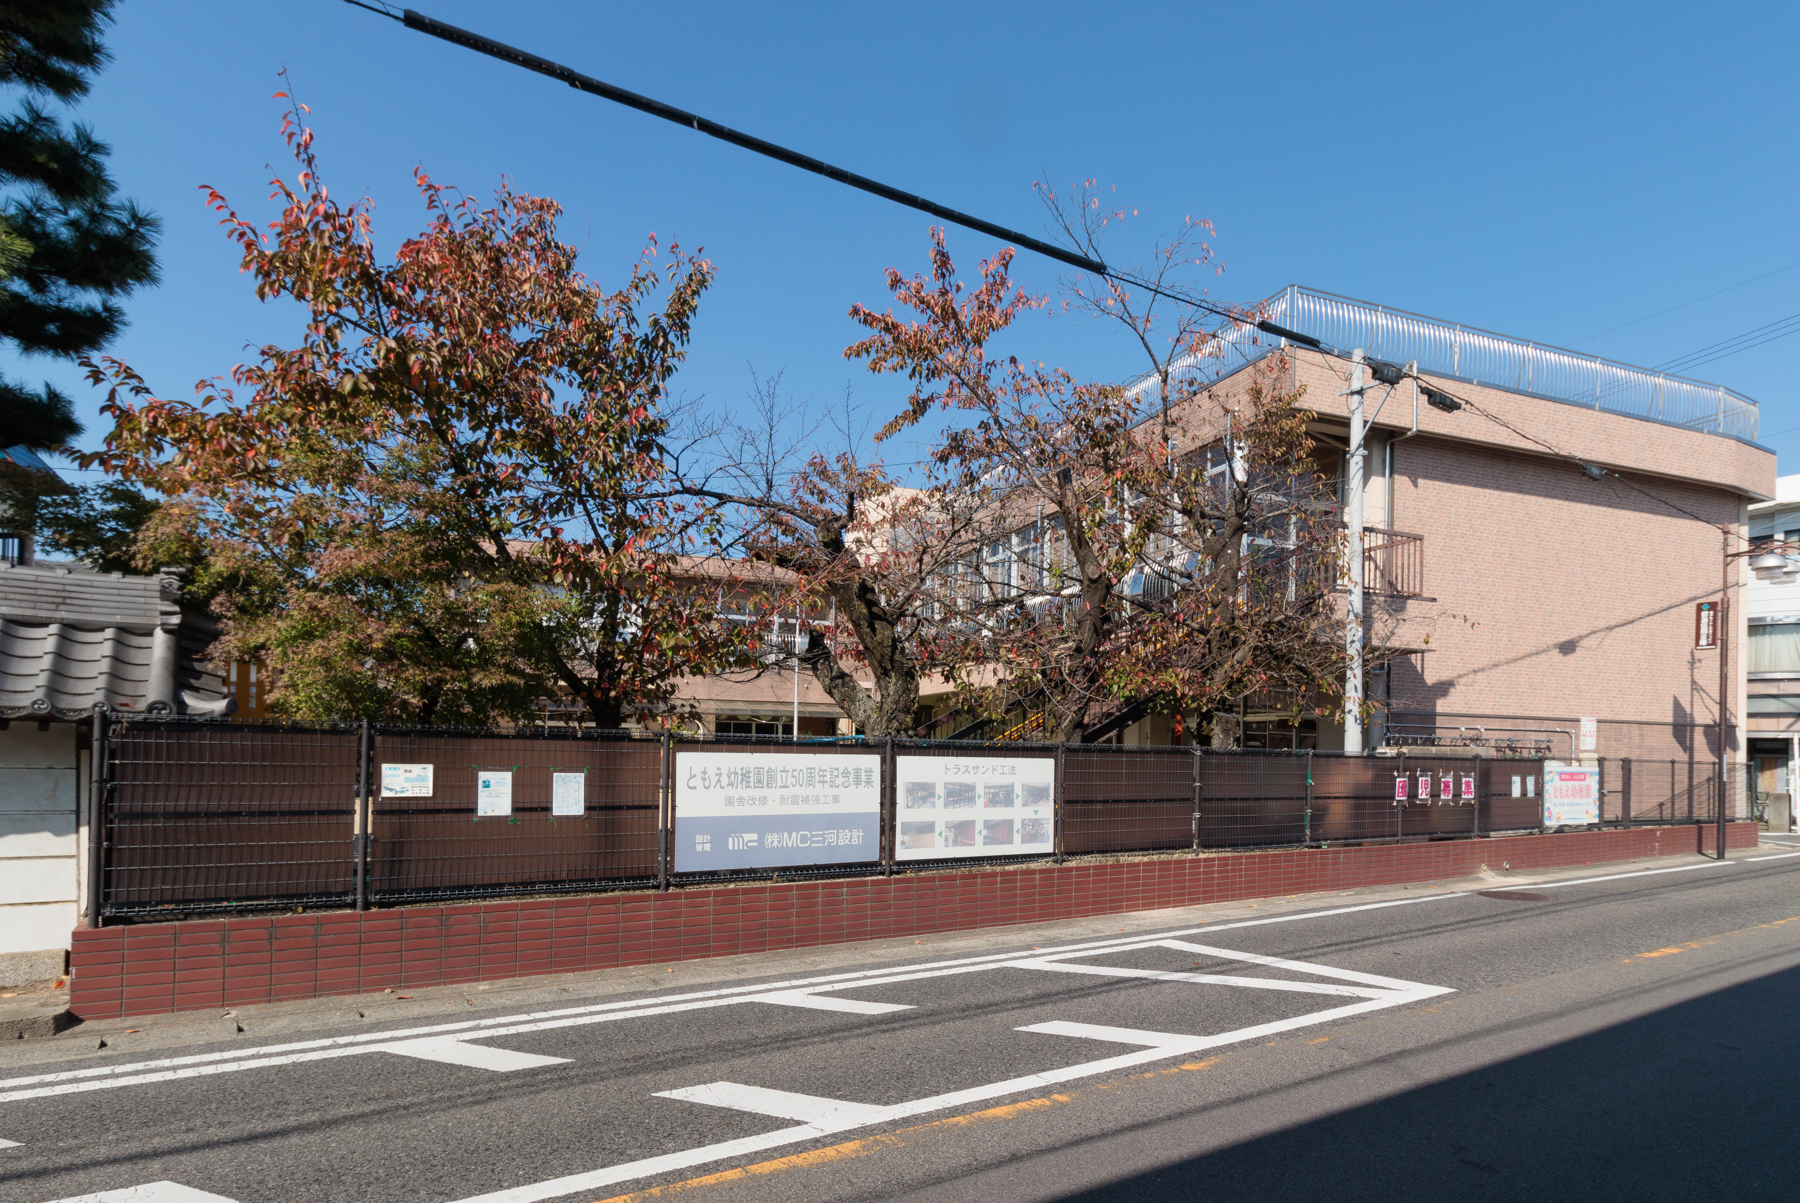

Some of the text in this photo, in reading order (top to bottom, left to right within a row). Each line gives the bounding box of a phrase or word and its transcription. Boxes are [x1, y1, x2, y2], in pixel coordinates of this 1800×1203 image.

[944, 764, 1017, 775] トラスサンド工法
[686, 766, 874, 790] ともえ幼稚園創立50周年記念事業
[724, 794, 841, 807] 園舎改修・耐震補強工事
